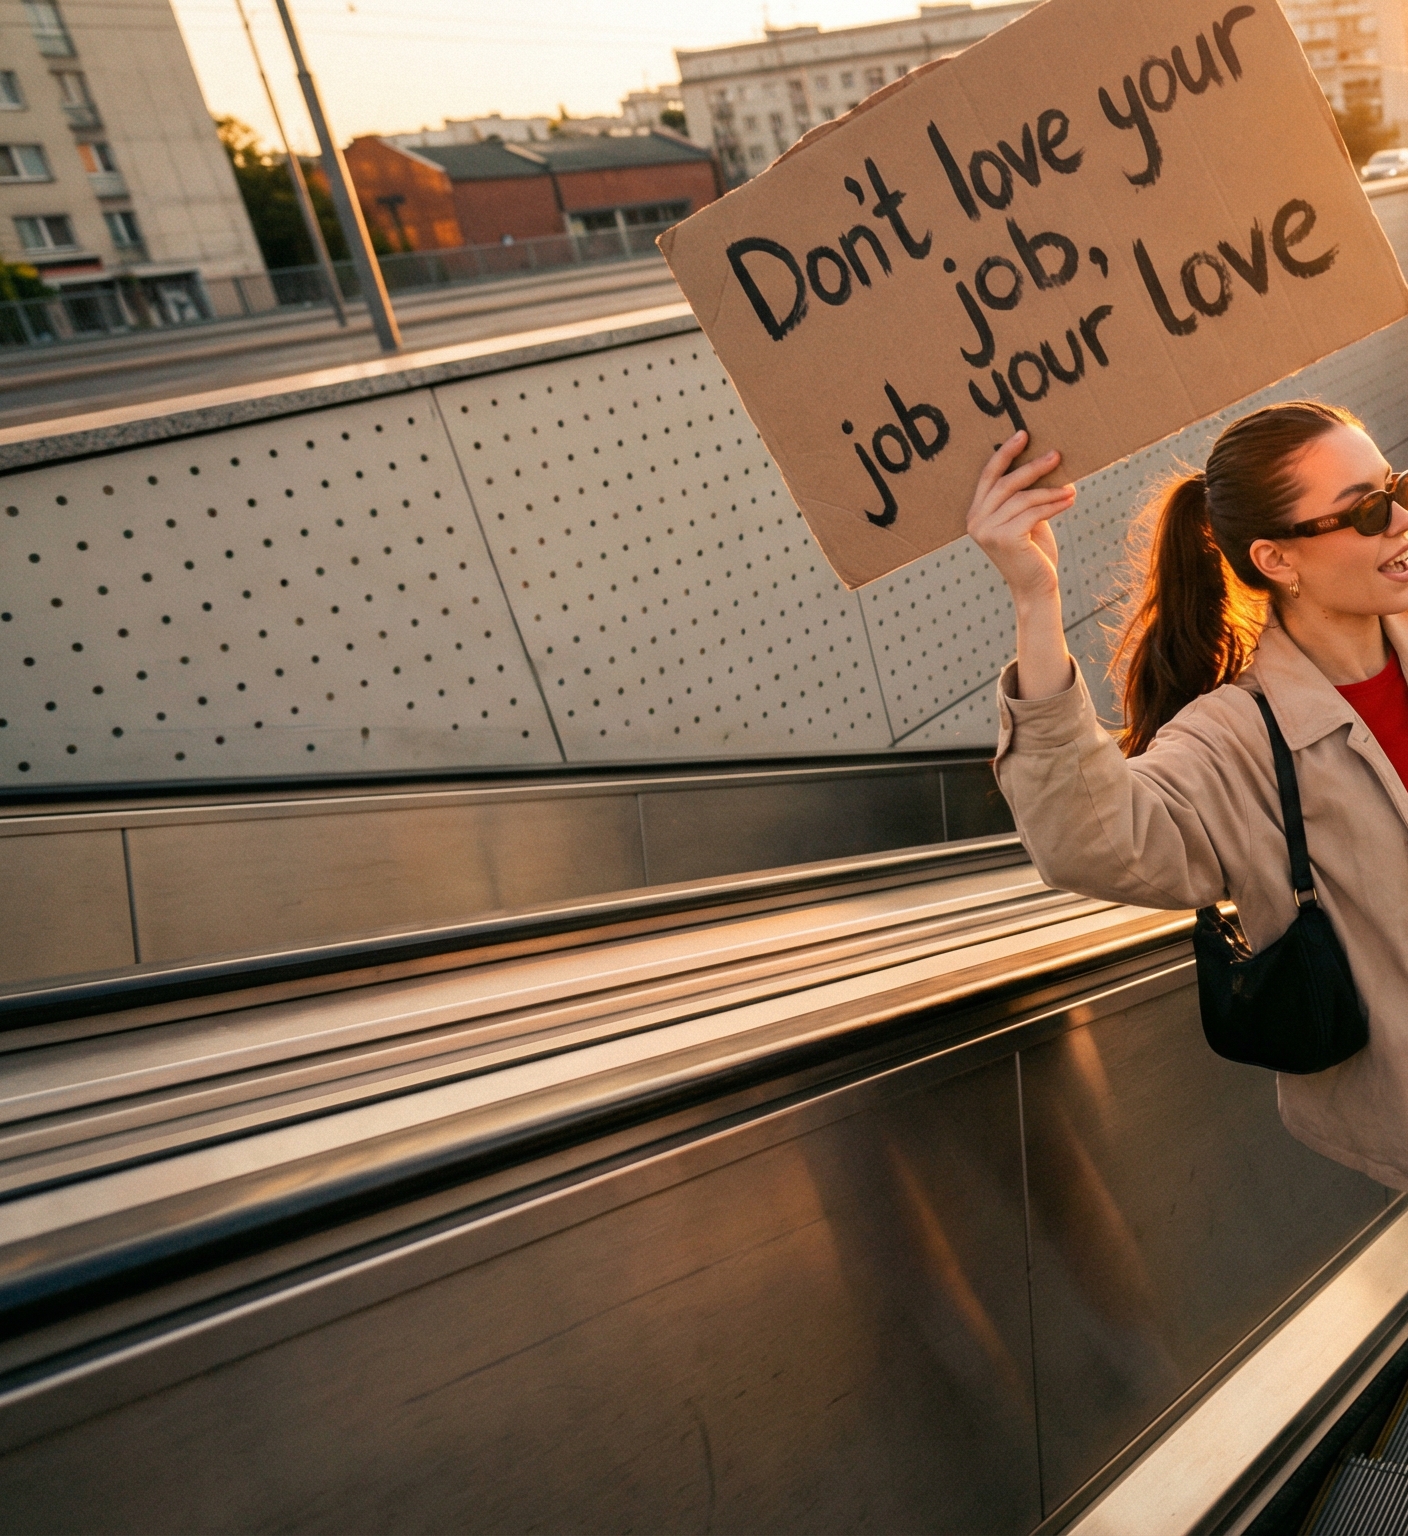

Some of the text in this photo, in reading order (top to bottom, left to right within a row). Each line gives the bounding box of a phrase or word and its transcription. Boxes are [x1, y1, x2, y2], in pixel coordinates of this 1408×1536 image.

[725, 4, 1256, 342] Don't love your
[942, 217, 1109, 369] job,
[840, 379, 952, 530] job
[967, 303, 1115, 452] your
